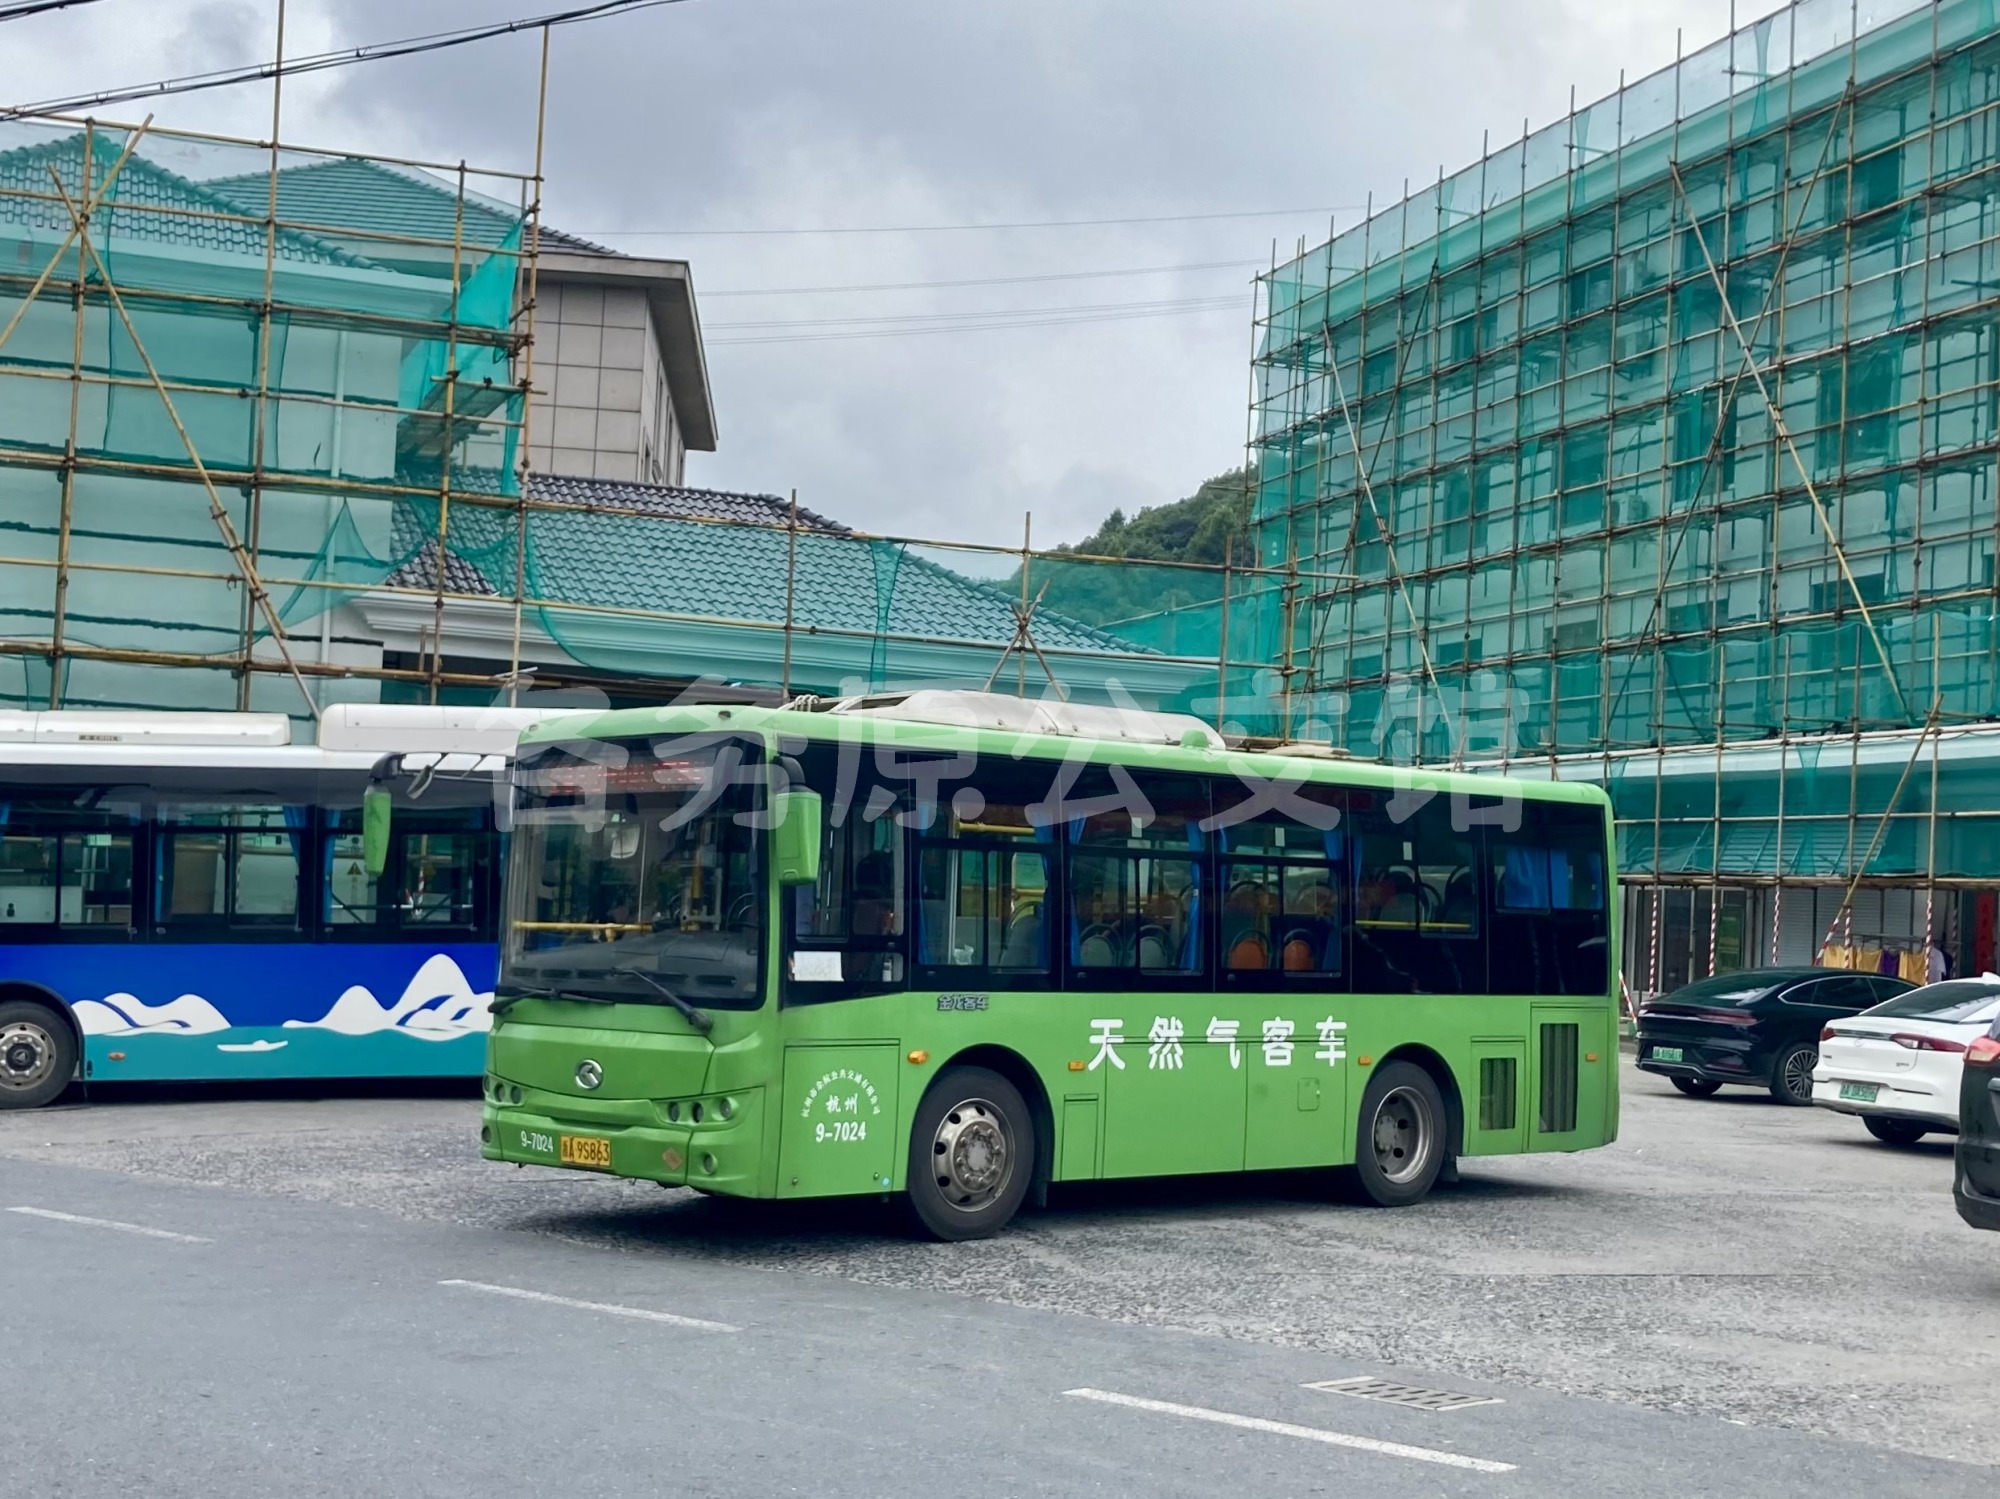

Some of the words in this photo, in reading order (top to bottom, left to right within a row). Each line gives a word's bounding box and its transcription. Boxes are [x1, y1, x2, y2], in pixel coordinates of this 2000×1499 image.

[937, 994, 989, 1011] 金龙客车
[1087, 1015, 1347, 1071] 天然气客车
[825, 1093, 859, 1115] 杭州
[520, 1130, 554, 1153] 9-7024
[815, 1121, 867, 1143] 9-7024
